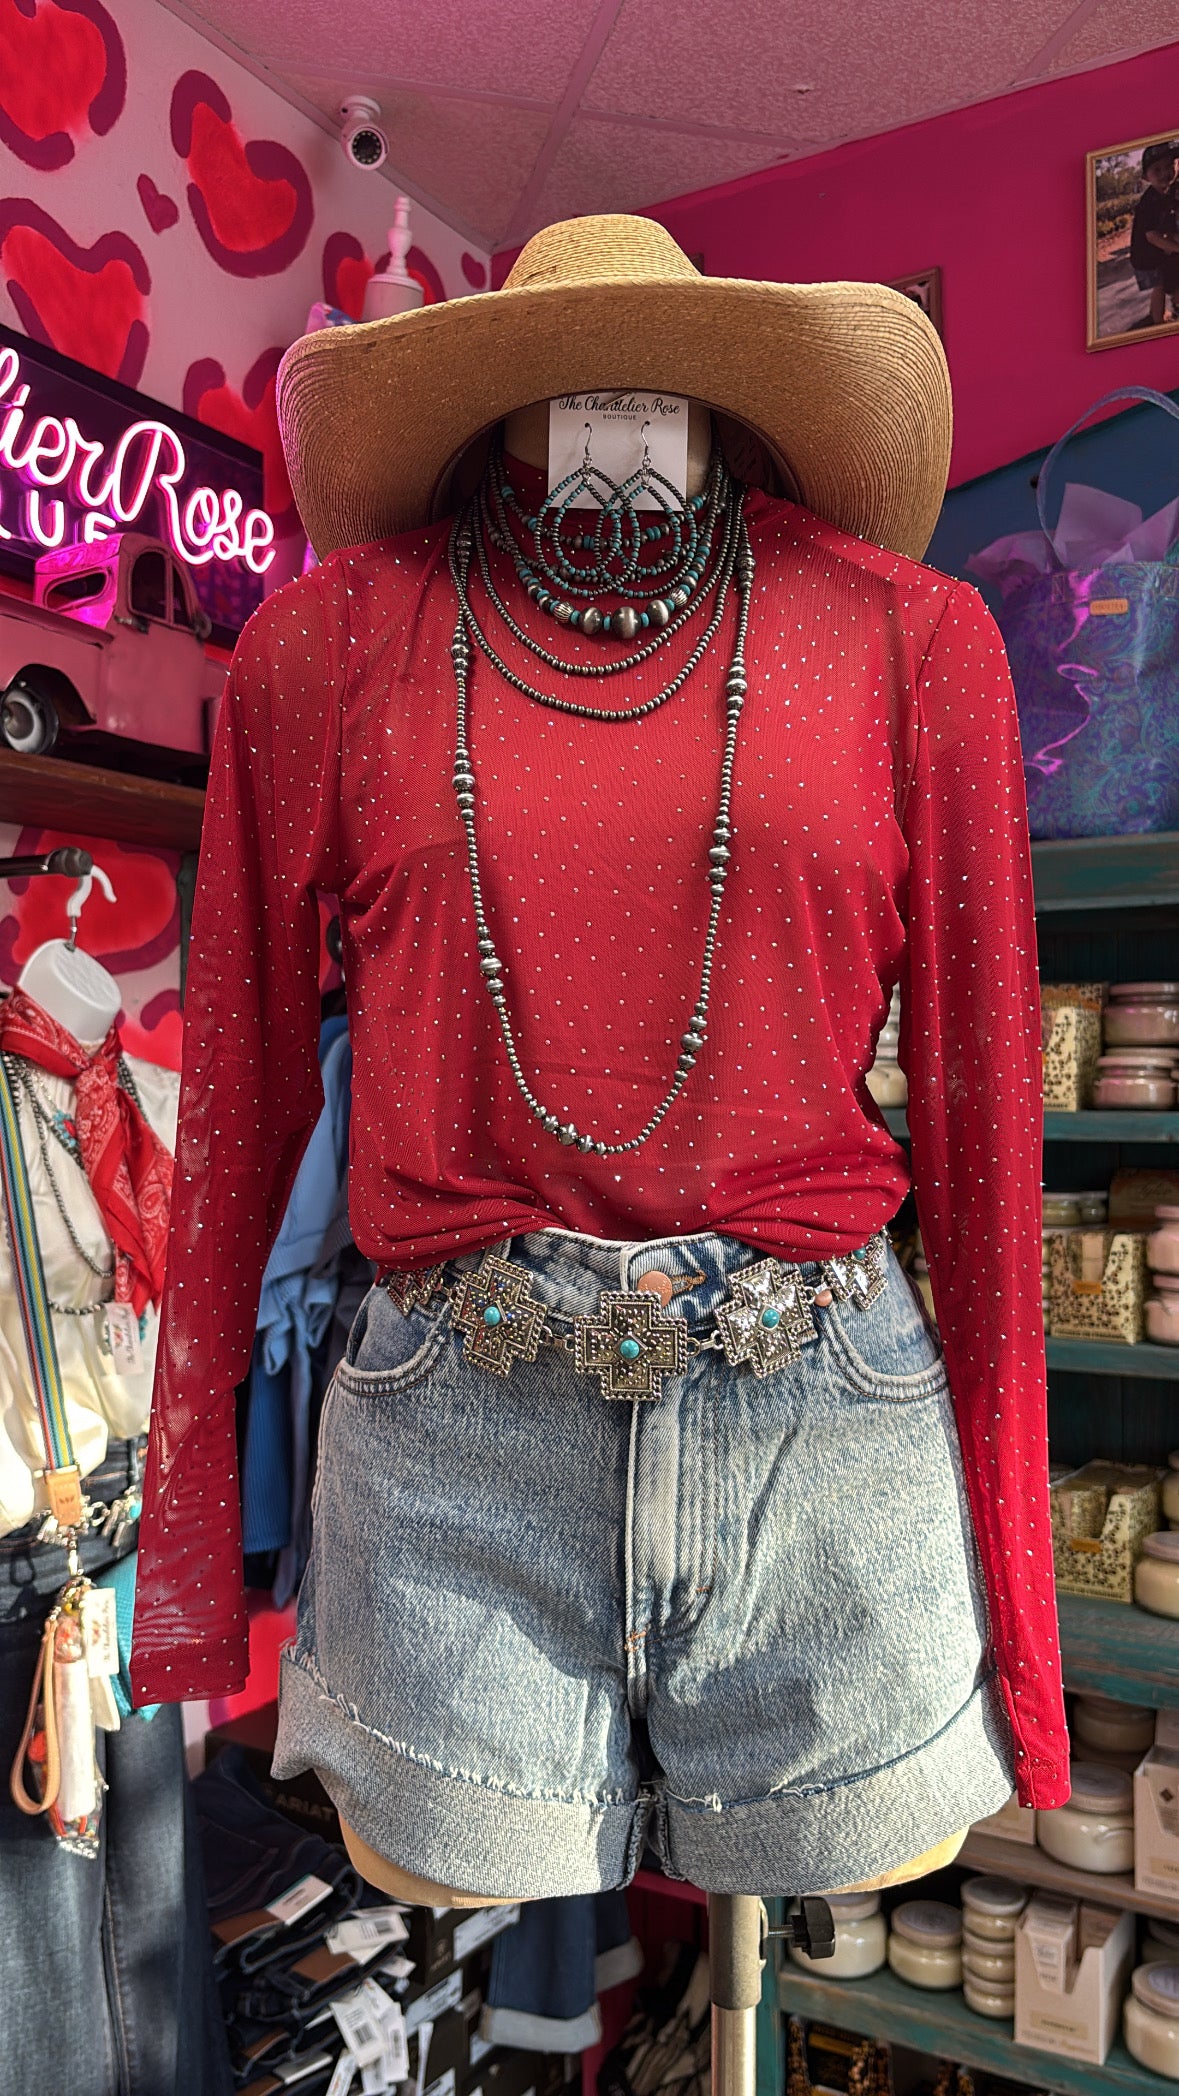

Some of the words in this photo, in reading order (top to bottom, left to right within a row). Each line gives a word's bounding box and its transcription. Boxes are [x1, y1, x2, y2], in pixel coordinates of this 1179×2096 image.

[559, 395, 582, 411] The
[651, 397, 680, 416] Rose
[110, 420, 276, 574] Rose
